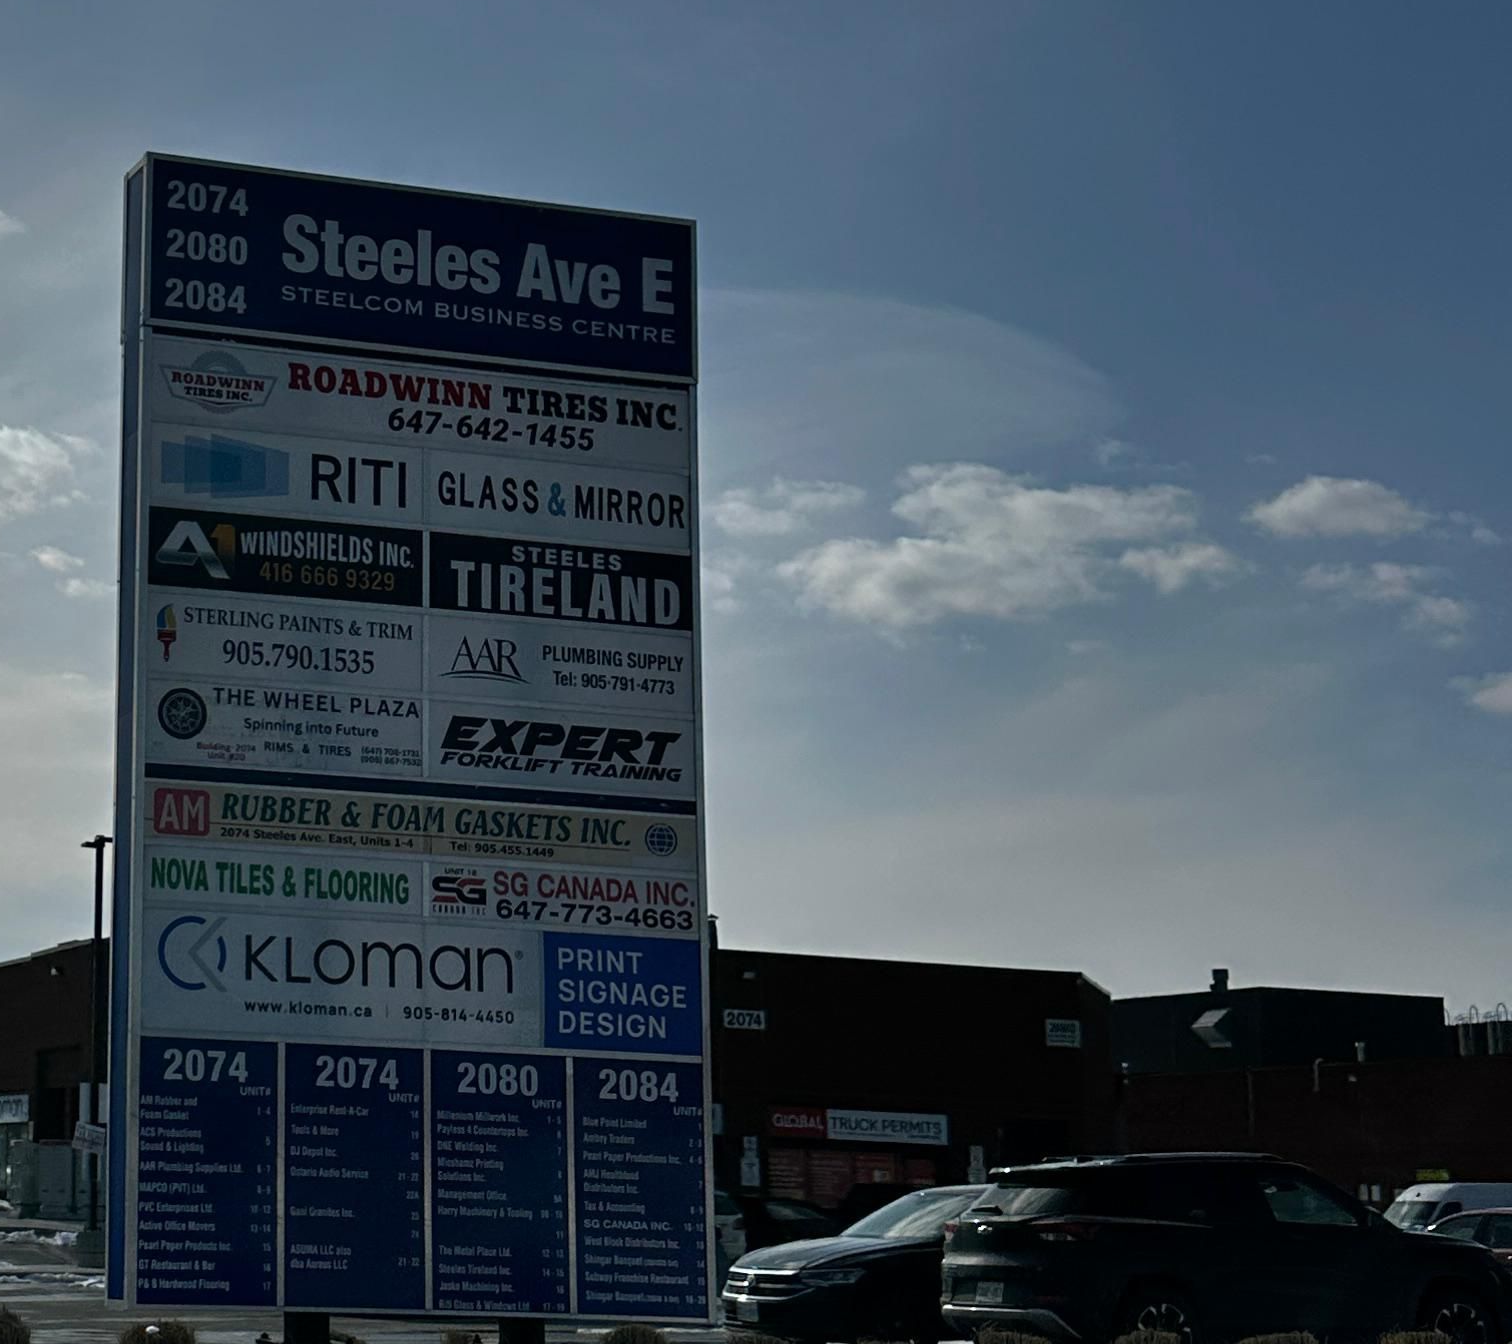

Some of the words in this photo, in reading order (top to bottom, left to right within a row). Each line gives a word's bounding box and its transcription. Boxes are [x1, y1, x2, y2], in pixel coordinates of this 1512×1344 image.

[167, 179, 248, 216] 2074
[166, 228, 248, 265] 2080
[281, 213, 501, 295] Steeles
[516, 242, 621, 310] Ave
[641, 256, 675, 315] E
[164, 277, 248, 314] 2084
[281, 285, 424, 316] STEELCOM
[435, 301, 564, 332] BUSINESS
[572, 318, 677, 344] CENTRE
[171, 371, 265, 391] ROADWINN
[184, 386, 223, 399] TIRES
[226, 389, 253, 402] INC.
[288, 362, 492, 410] ROADWINN
[502, 386, 608, 423] TIRES
[616, 398, 683, 432] INC.
[388, 408, 594, 451] 647-642-1455
[311, 453, 407, 508] RITI
[438, 471, 539, 514] GLASS
[547, 482, 567, 517] &
[575, 484, 685, 529] MIRROR
[155, 520, 236, 580] A1
[240, 530, 373, 566] WINDSHIELDS
[378, 540, 415, 569] INC.
[511, 545, 624, 571] STEELES
[259, 561, 294, 583] 416
[300, 564, 338, 587] 666
[345, 569, 396, 592] 9329
[450, 559, 681, 626] TIRELAND
[184, 606, 274, 630] STERLING
[280, 614, 343, 636] PAINTS
[348, 620, 362, 636] &
[367, 621, 413, 640] TRIM
[223, 639, 375, 674] 905.790.1535
[451, 636, 522, 678] AAR
[543, 645, 623, 667] PLUMBING
[627, 652, 683, 672] SUPPLY
[553, 671, 577, 687] Tel:
[213, 687, 255, 706] THE
[263, 691, 341, 713] WHEEL
[350, 697, 420, 719] PLAZA
[244, 718, 302, 736] Spinning
[305, 722, 331, 734] into
[336, 724, 379, 738] Future
[440, 715, 682, 766] EXPERT
[264, 741, 294, 753] RIMS
[302, 743, 310, 754] &
[319, 744, 352, 757] TIRES
[440, 751, 564, 774] FORKLIFT
[570, 761, 683, 782] TRAINING
[158, 792, 206, 832] AM
[221, 793, 331, 826] RUBBER
[340, 800, 361, 828] &
[371, 803, 445, 834] FOAM
[454, 808, 572, 842] GASKETS
[581, 817, 631, 847] INC.
[220, 827, 249, 838] 2074
[254, 828, 296, 841] Steeles
[329, 834, 356, 846] East,
[360, 835, 391, 847] Units
[394, 838, 413, 848] 1-4
[451, 841, 471, 852] Tel:
[474, 843, 554, 857] 905.455.1449
[151, 857, 209, 891] NOVA
[215, 862, 274, 896] TILES
[282, 865, 296, 897] &
[304, 868, 409, 904] FLOORING
[432, 876, 487, 905] SG
[493, 870, 528, 897] SG
[537, 874, 638, 903] CANADA
[646, 880, 695, 907] INC.
[496, 899, 694, 930] 647-773-4663
[557, 946, 643, 975] PRINT
[558, 978, 688, 1008] SIGNAGE
[244, 1001, 372, 1018] www.kloman.ca
[403, 1006, 515, 1024] 905-814-4450
[558, 1009, 667, 1039] DESIGN
[726, 1012, 762, 1027] 2074
[163, 1047, 248, 1083] 2074
[315, 1055, 399, 1090] 2074
[457, 1061, 538, 1096] 2080
[598, 1068, 679, 1103] 2084
[772, 1113, 825, 1129] GLOBAL
[830, 1116, 878, 1132] TRUCK
[882, 1118, 942, 1135] PERMITS
[583, 1219, 600, 1228] SG
[603, 1219, 648, 1230] CANADA
